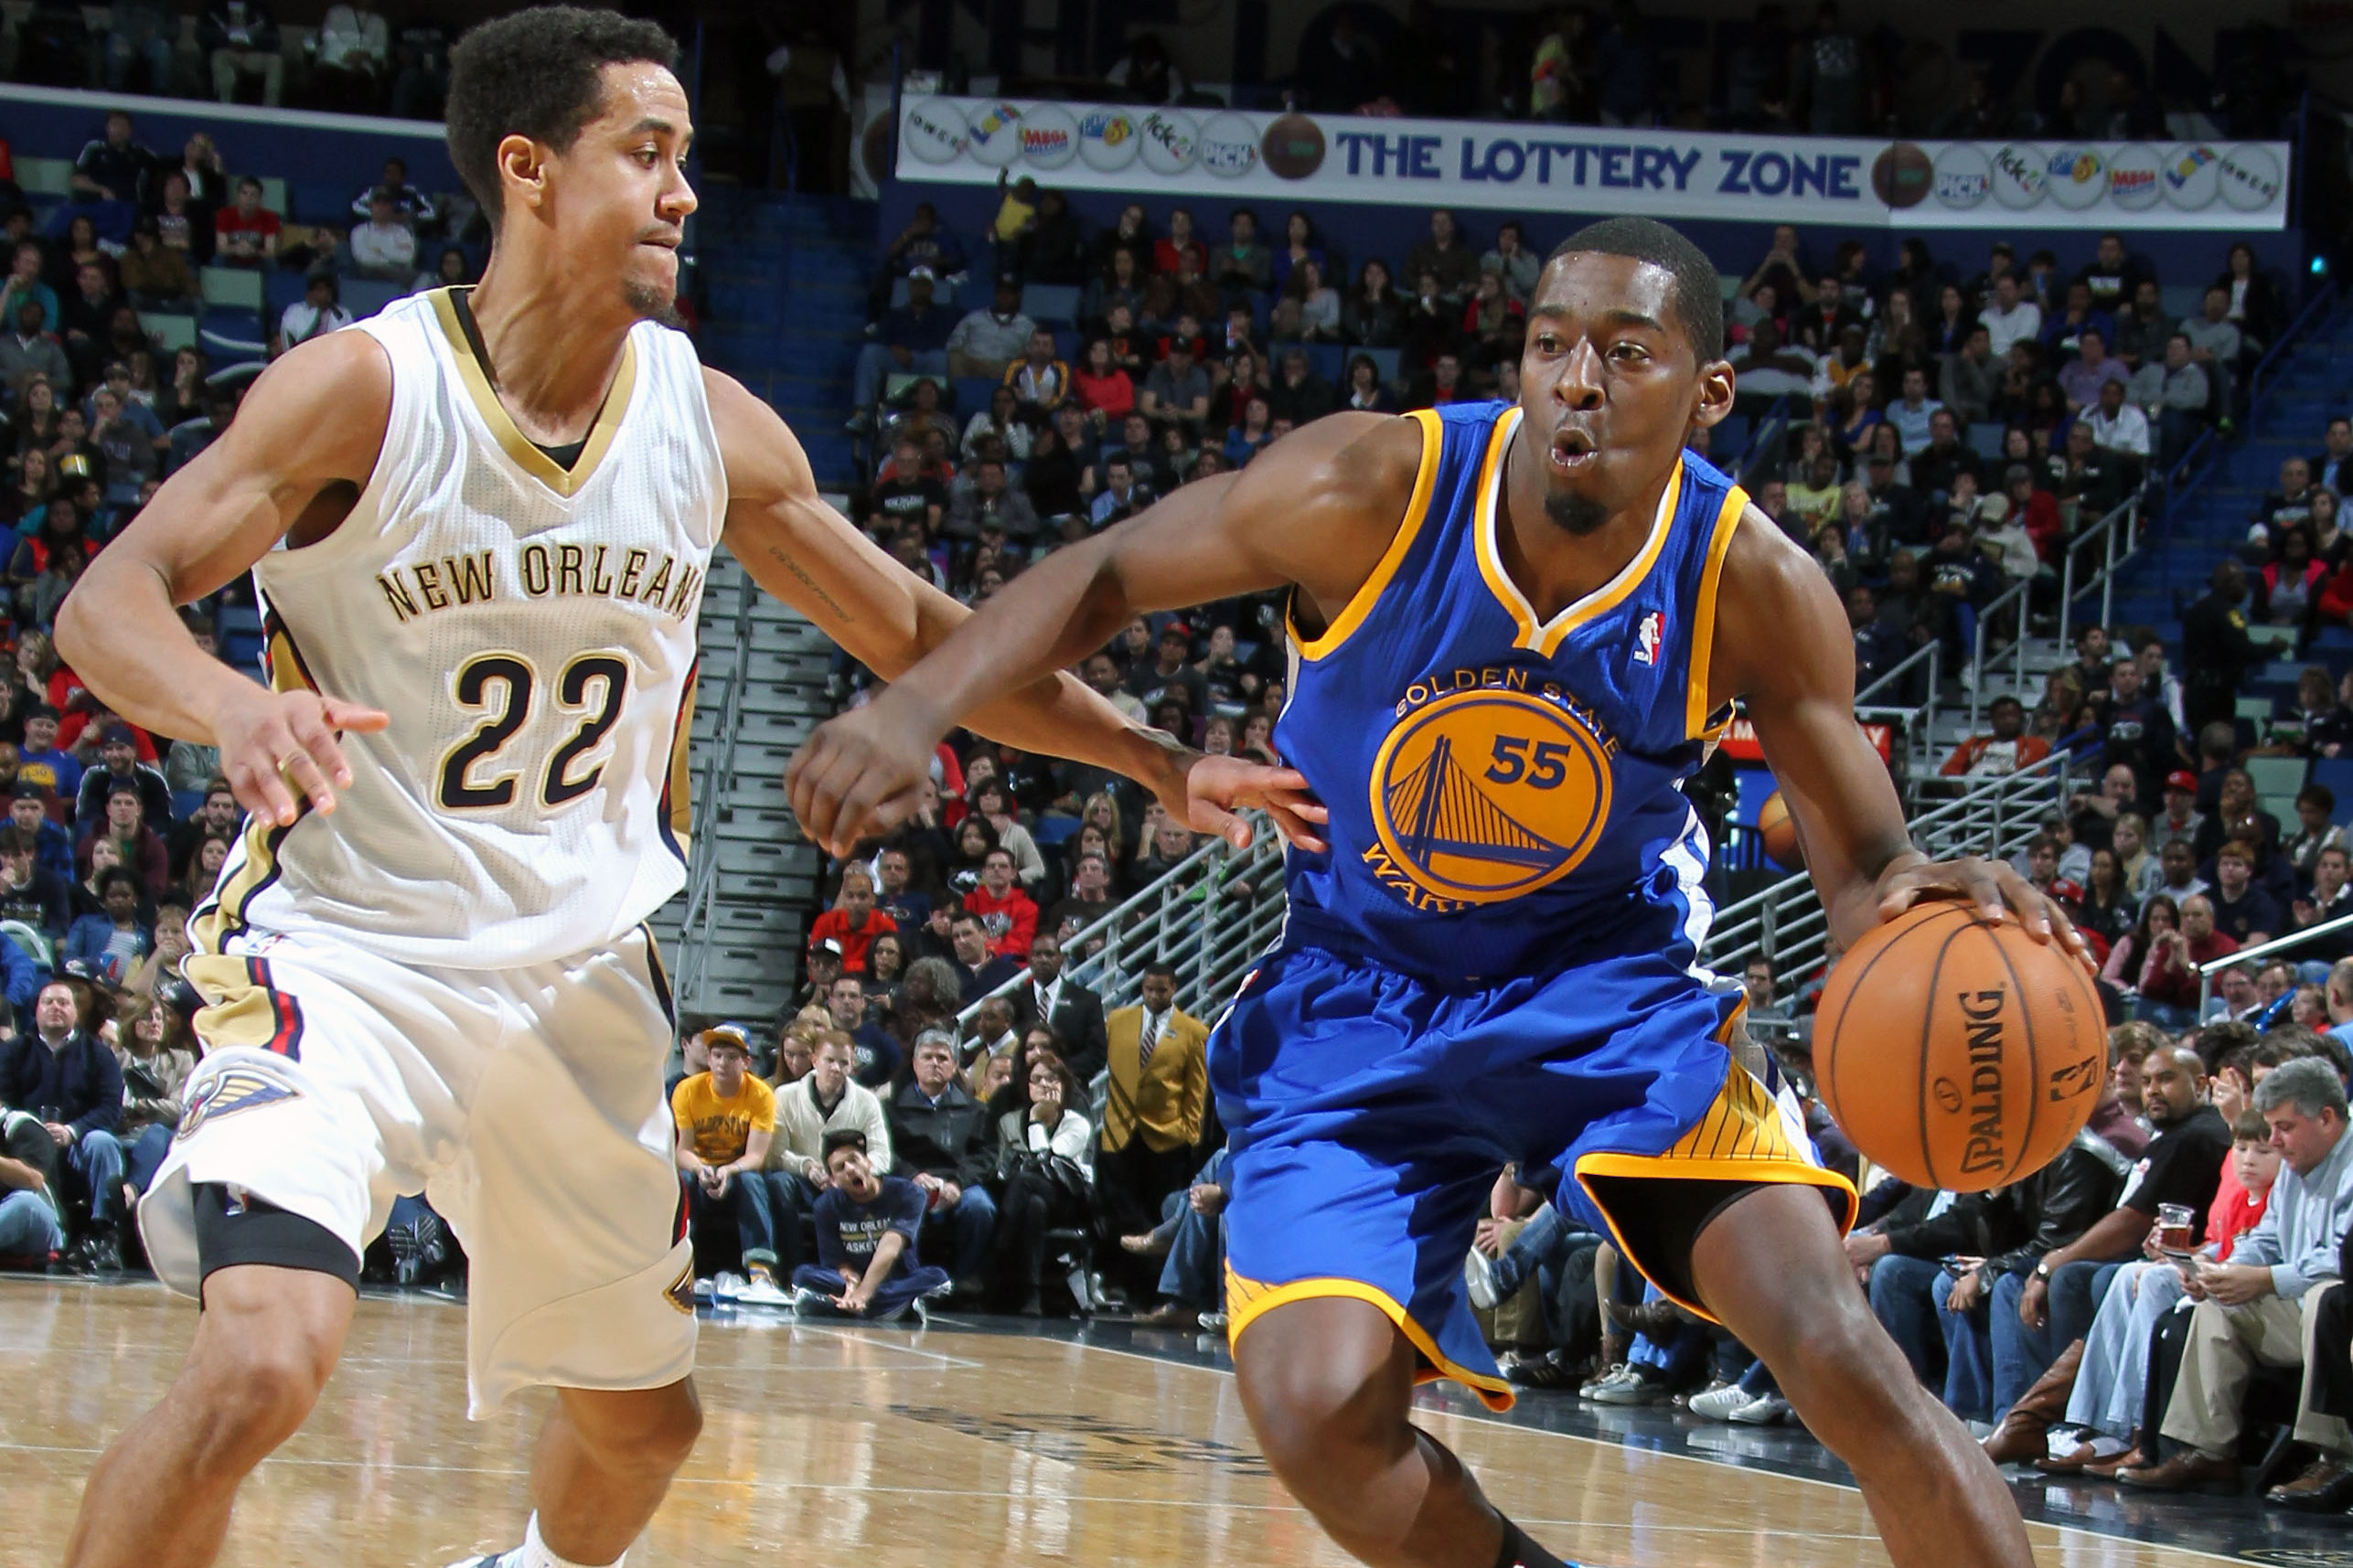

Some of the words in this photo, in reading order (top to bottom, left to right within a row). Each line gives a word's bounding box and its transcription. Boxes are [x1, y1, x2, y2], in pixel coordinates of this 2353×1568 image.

[1336, 133, 1442, 179] THE
[1460, 137, 1702, 190] LOTTERY
[1717, 150, 1861, 199] ZONE
[376, 549, 495, 623] NEW
[434, 650, 633, 812] 22
[1396, 667, 1527, 719] GOLDEN
[1543, 683, 1621, 762] STATE
[1484, 734, 1571, 789] 55
[1958, 990, 2005, 1174] SPALDING
[839, 1221, 858, 1232] NEW
